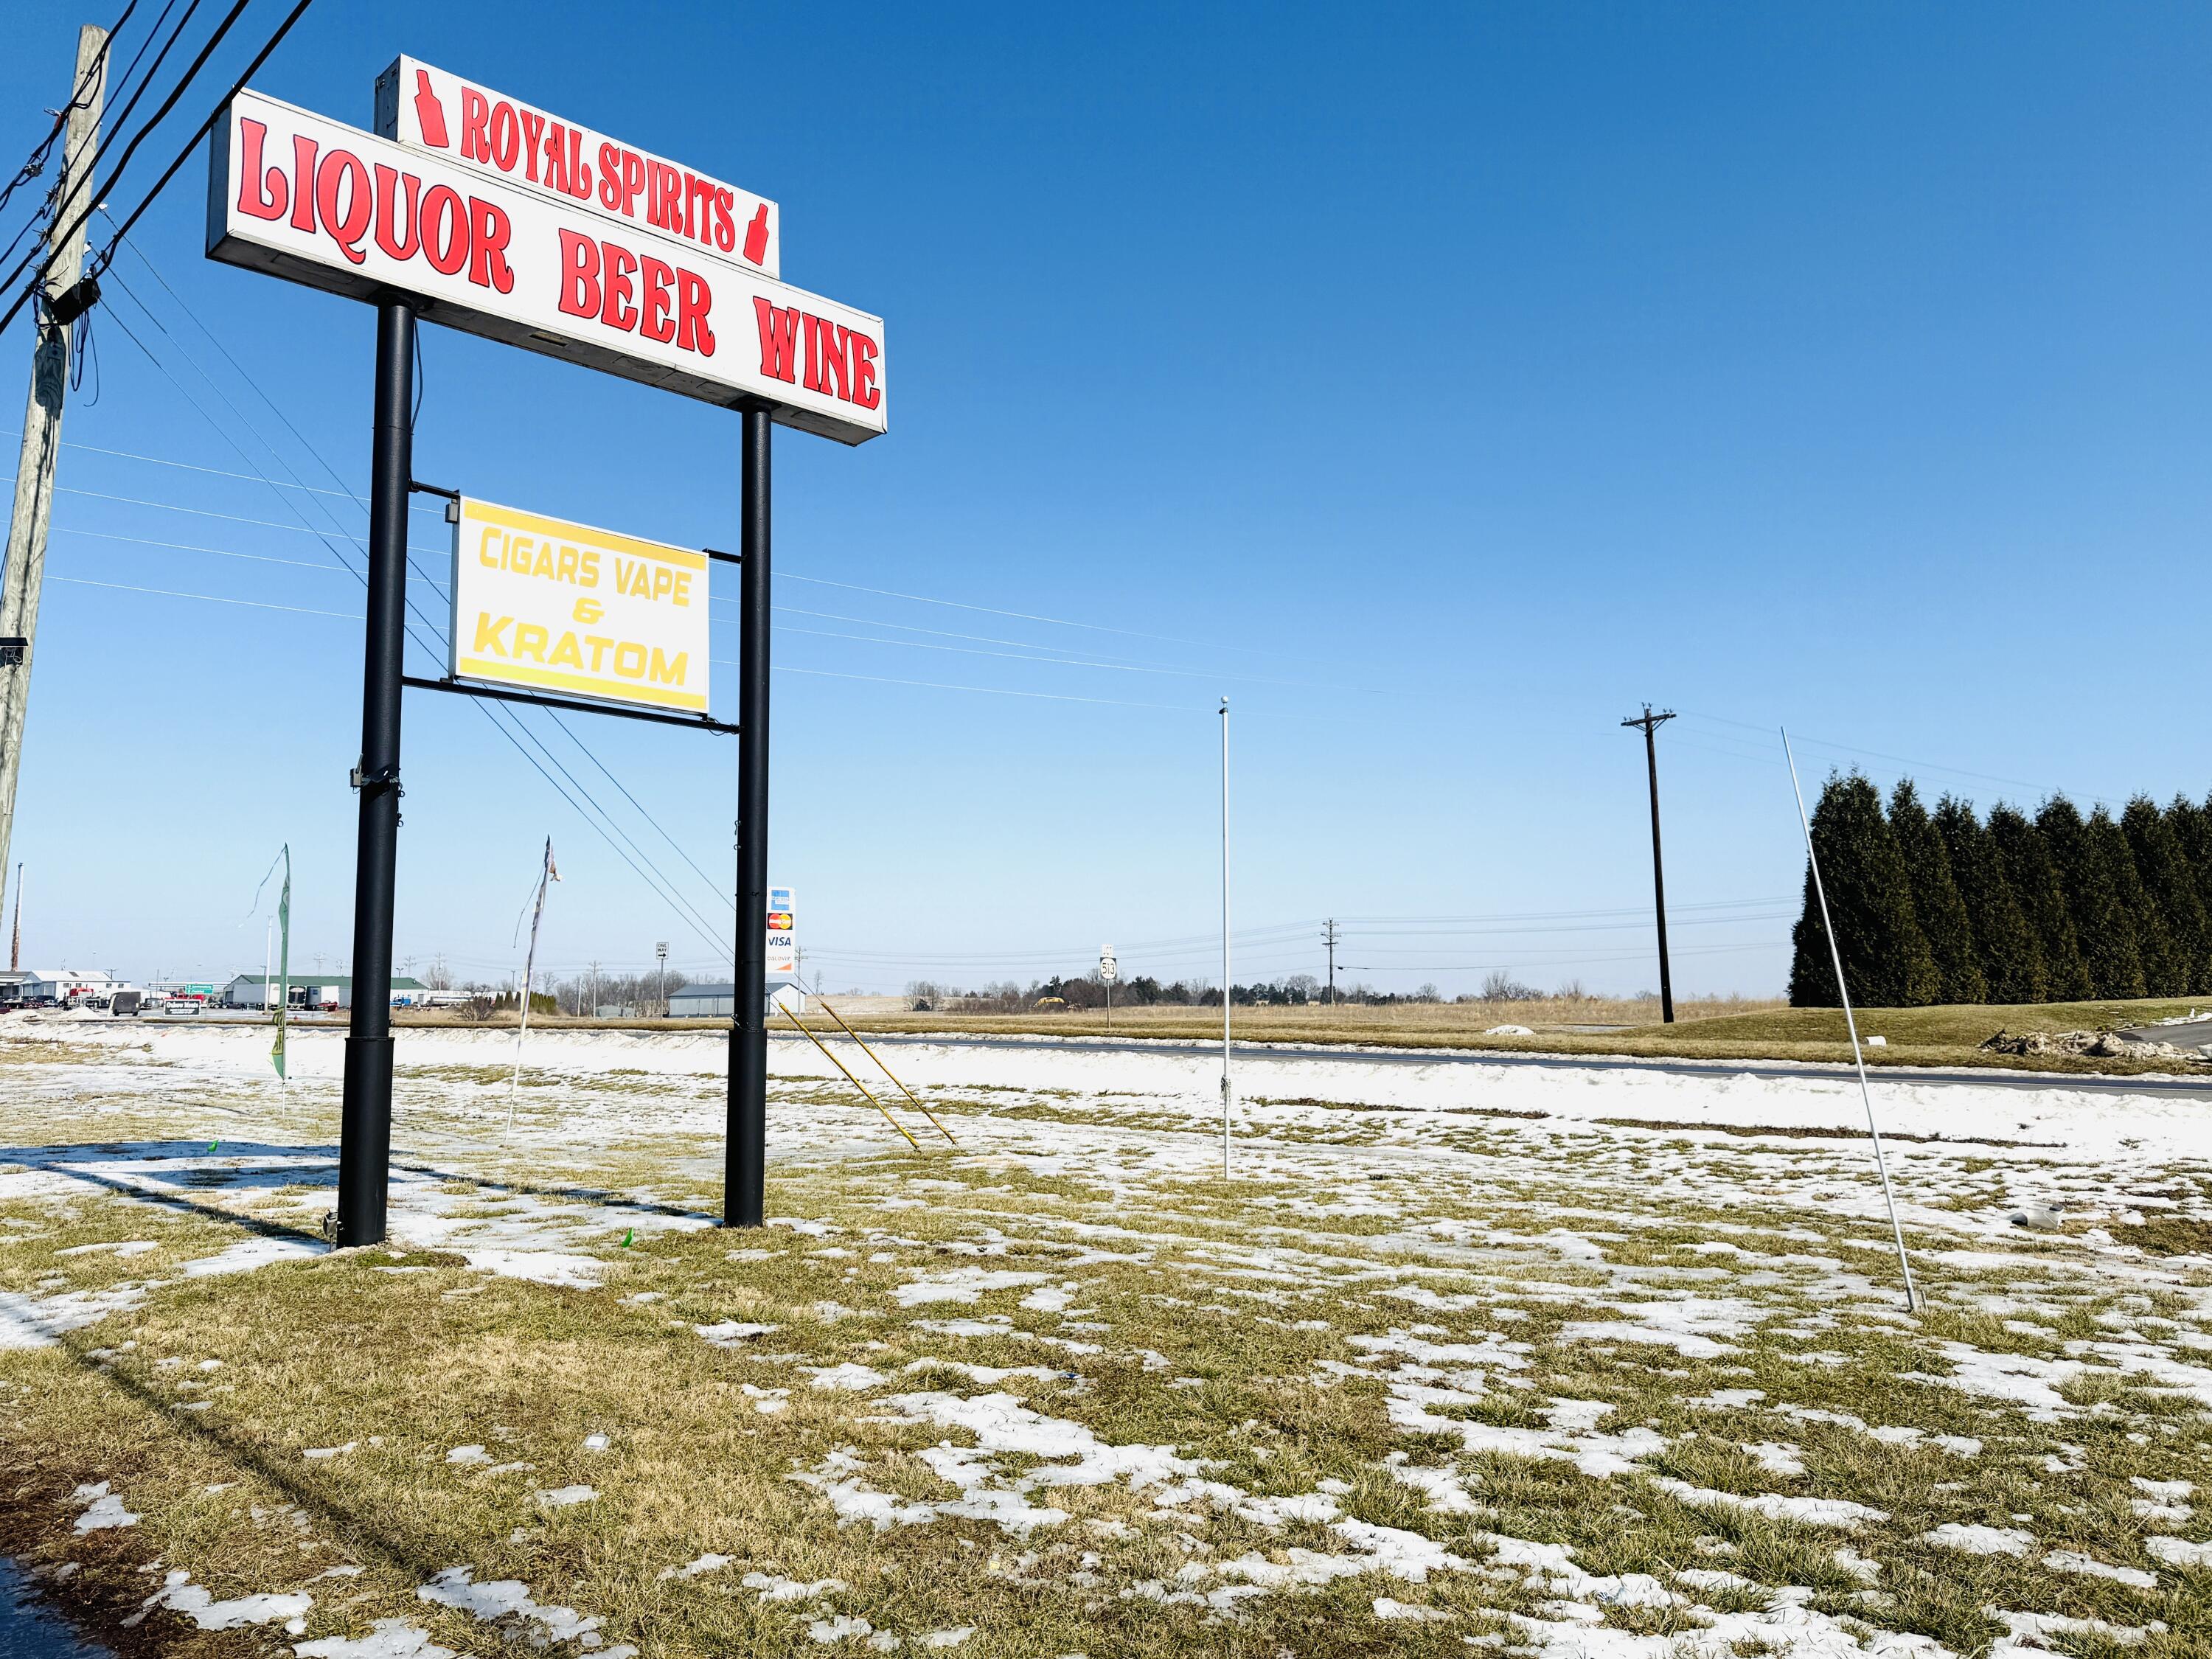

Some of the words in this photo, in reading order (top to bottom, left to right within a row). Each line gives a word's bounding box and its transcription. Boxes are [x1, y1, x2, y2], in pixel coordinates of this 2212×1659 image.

[460, 86, 593, 201] ROYAL
[598, 142, 736, 254] SPIRITS
[237, 116, 515, 295] LIQUOR
[558, 227, 716, 357] BEER
[752, 296, 880, 411] WINE
[479, 526, 600, 588] CIGARS
[614, 557, 692, 607] VAPE
[473, 611, 689, 686] KRATOM
[571, 597, 605, 625] &
[768, 936, 791, 947] VISA
[1102, 962, 1115, 975] 513
